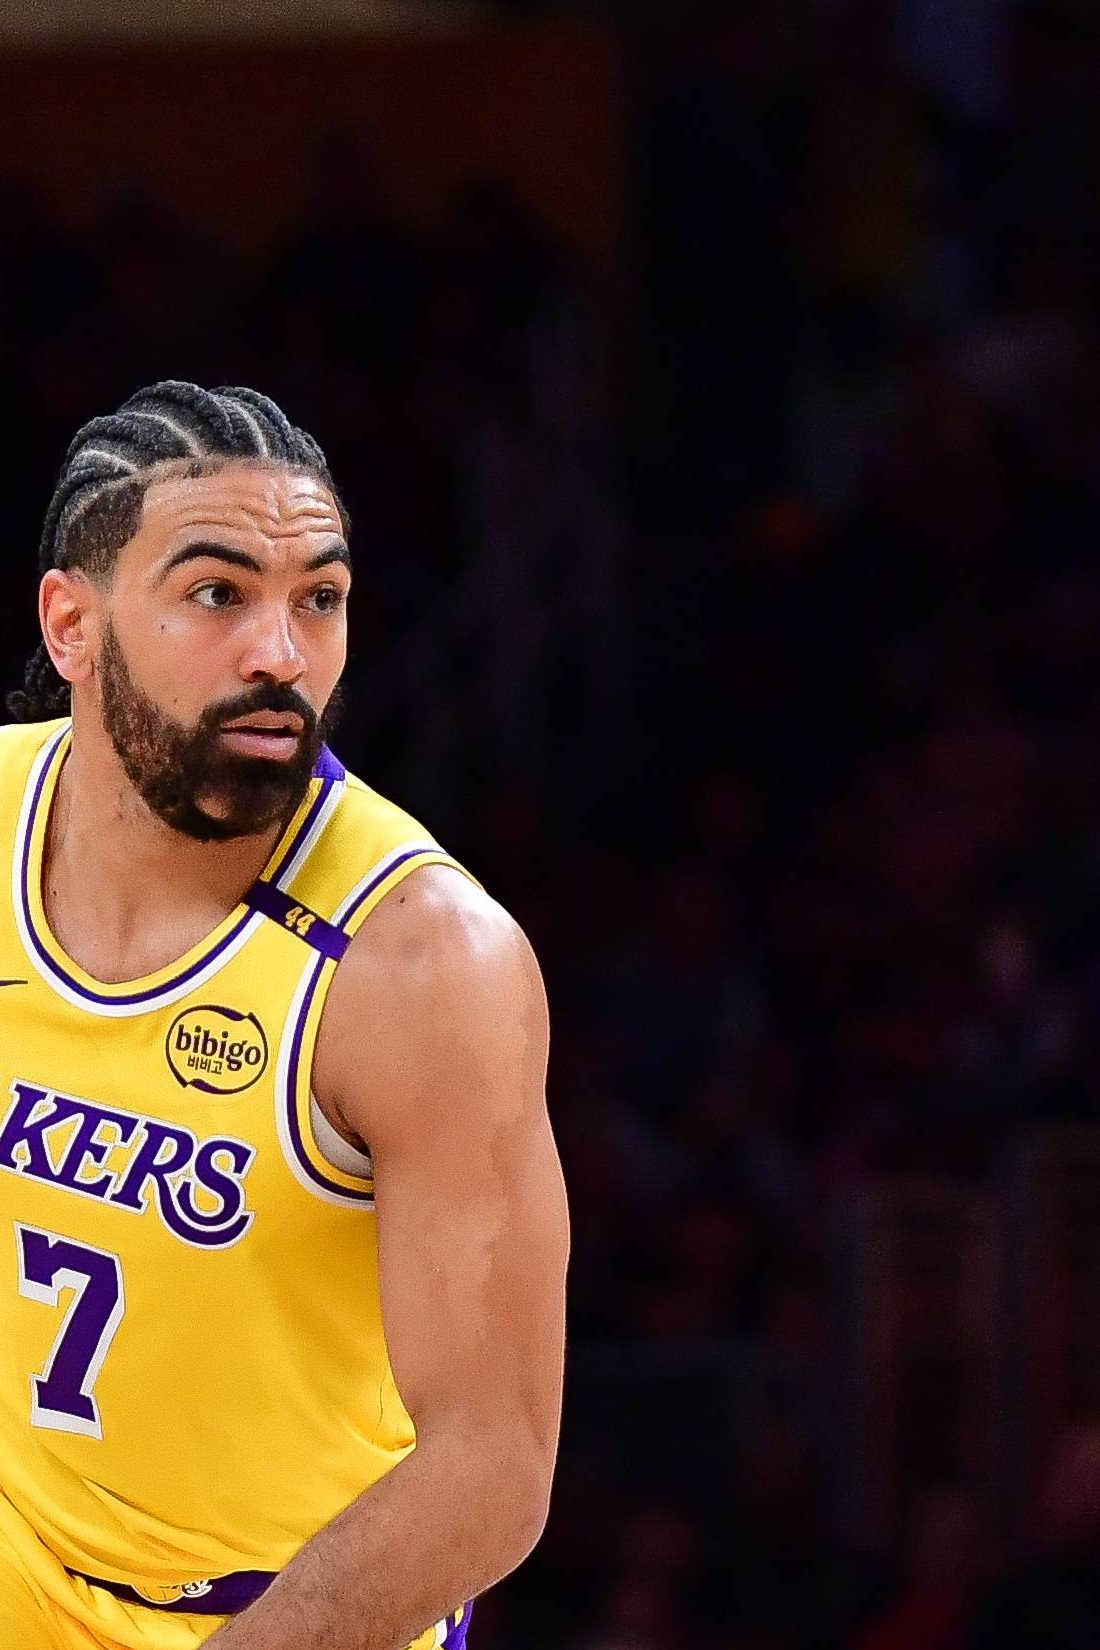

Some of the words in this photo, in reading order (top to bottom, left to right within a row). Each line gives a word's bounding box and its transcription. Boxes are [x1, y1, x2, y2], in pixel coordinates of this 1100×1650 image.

[286, 907, 316, 936] 44
[176, 1024, 261, 1071] bibigo
[187, 1055, 223, 1075] 비비고
[13, 1221, 126, 1440] 7
